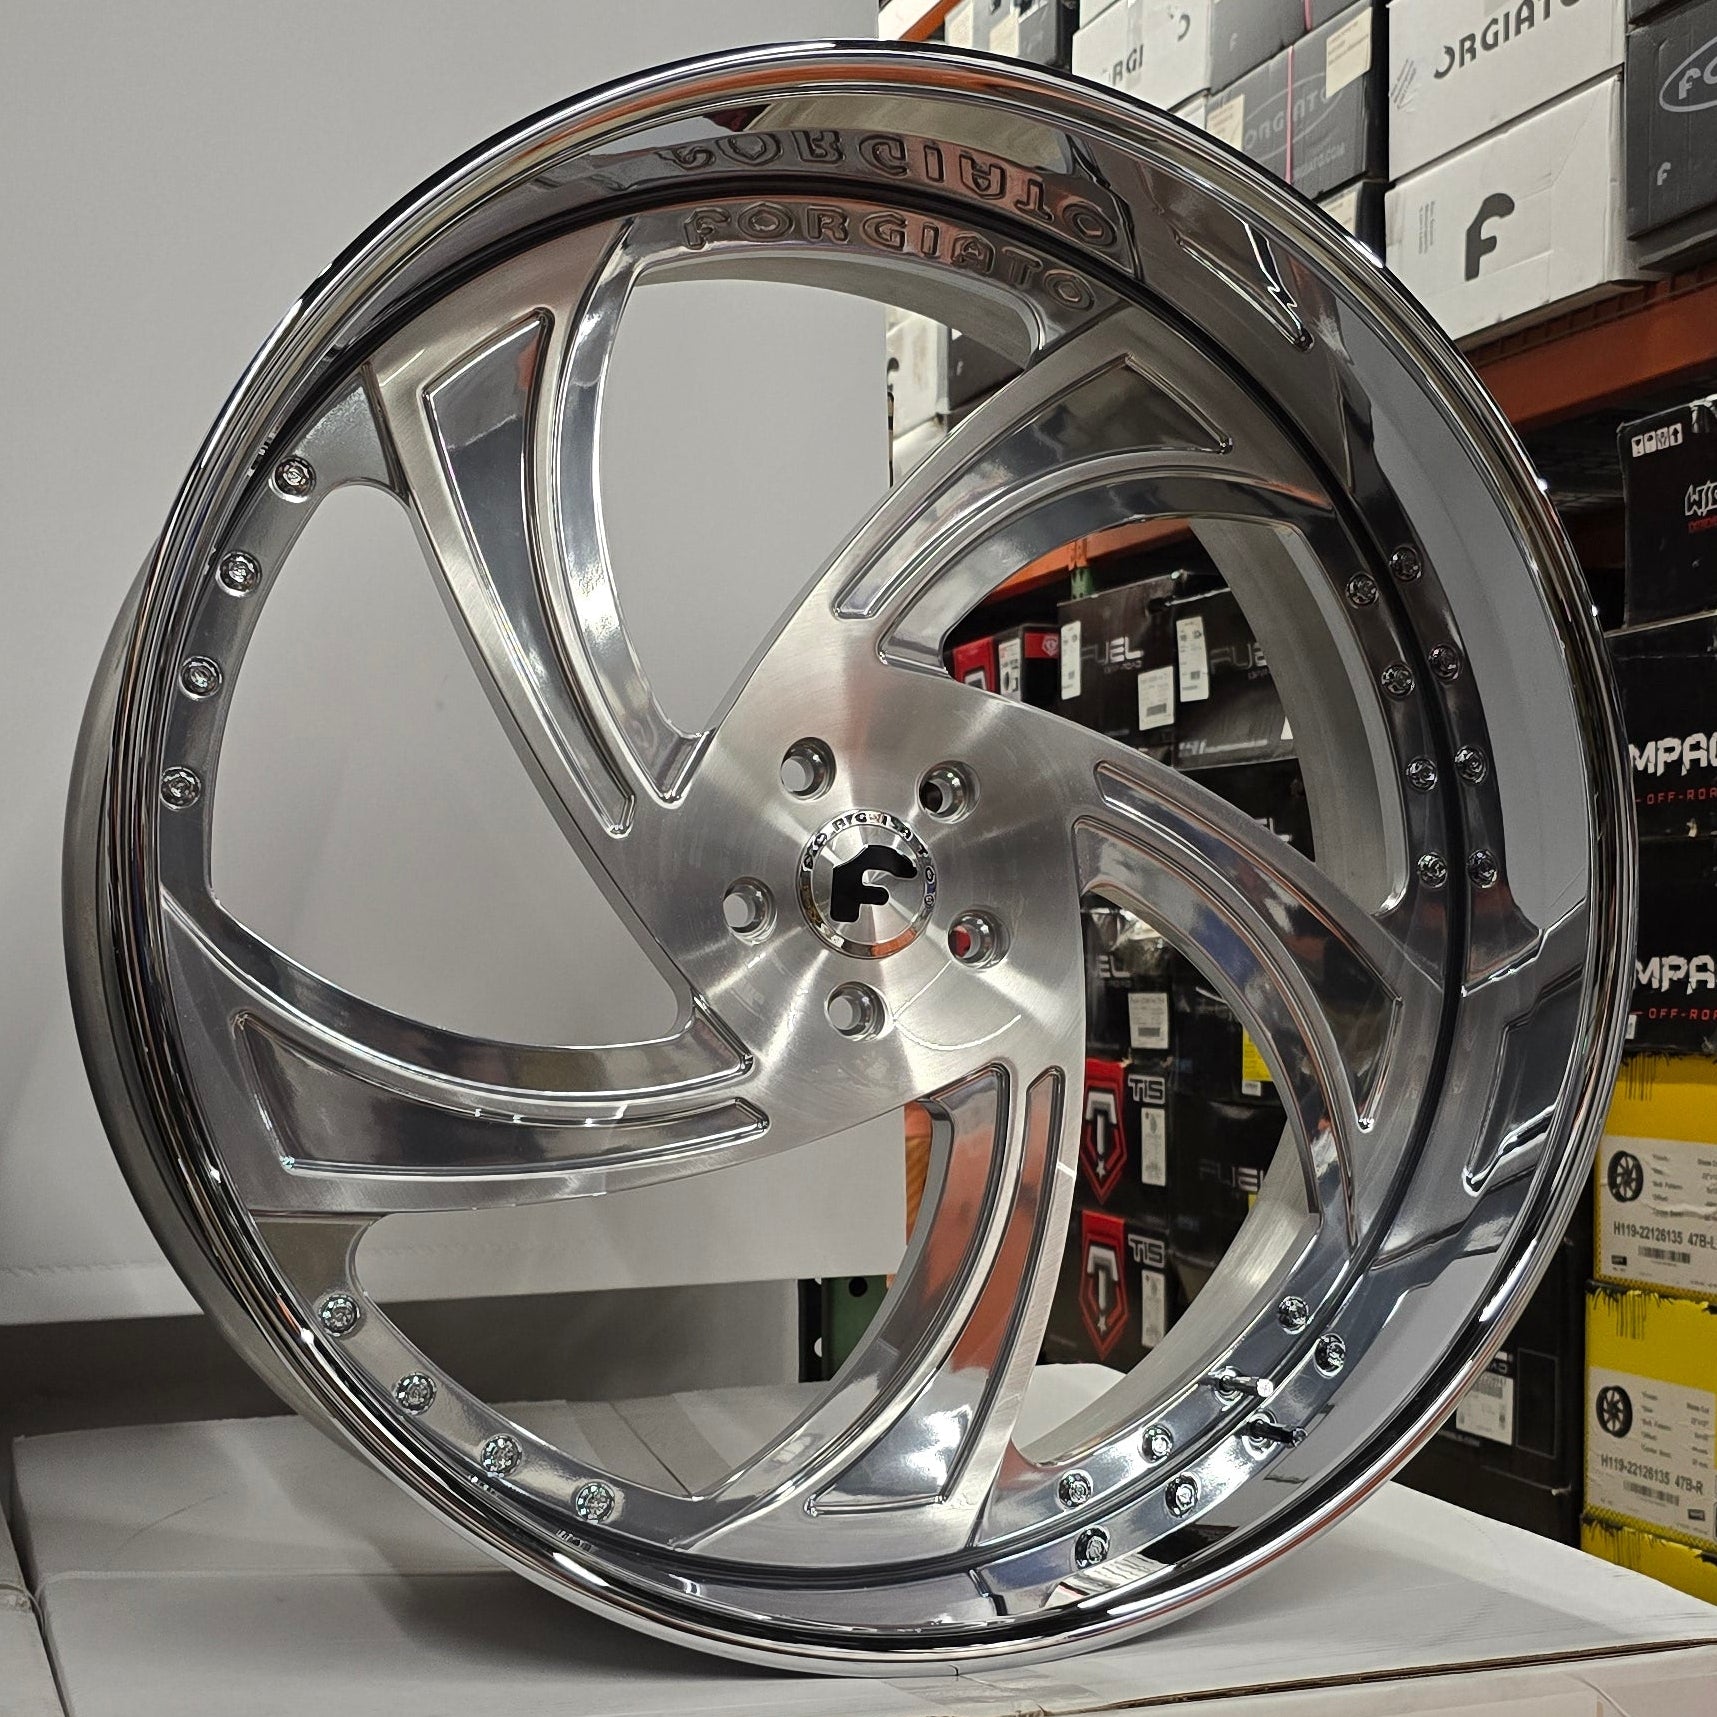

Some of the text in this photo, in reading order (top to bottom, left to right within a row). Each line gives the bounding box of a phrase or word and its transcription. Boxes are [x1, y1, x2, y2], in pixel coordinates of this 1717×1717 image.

[681, 201, 1096, 311] FORGIATO
[1127, 1074, 1166, 1105] TIS
[1613, 1220, 1684, 1246] H119-22126135
[1127, 1233, 1166, 1269] TIS
